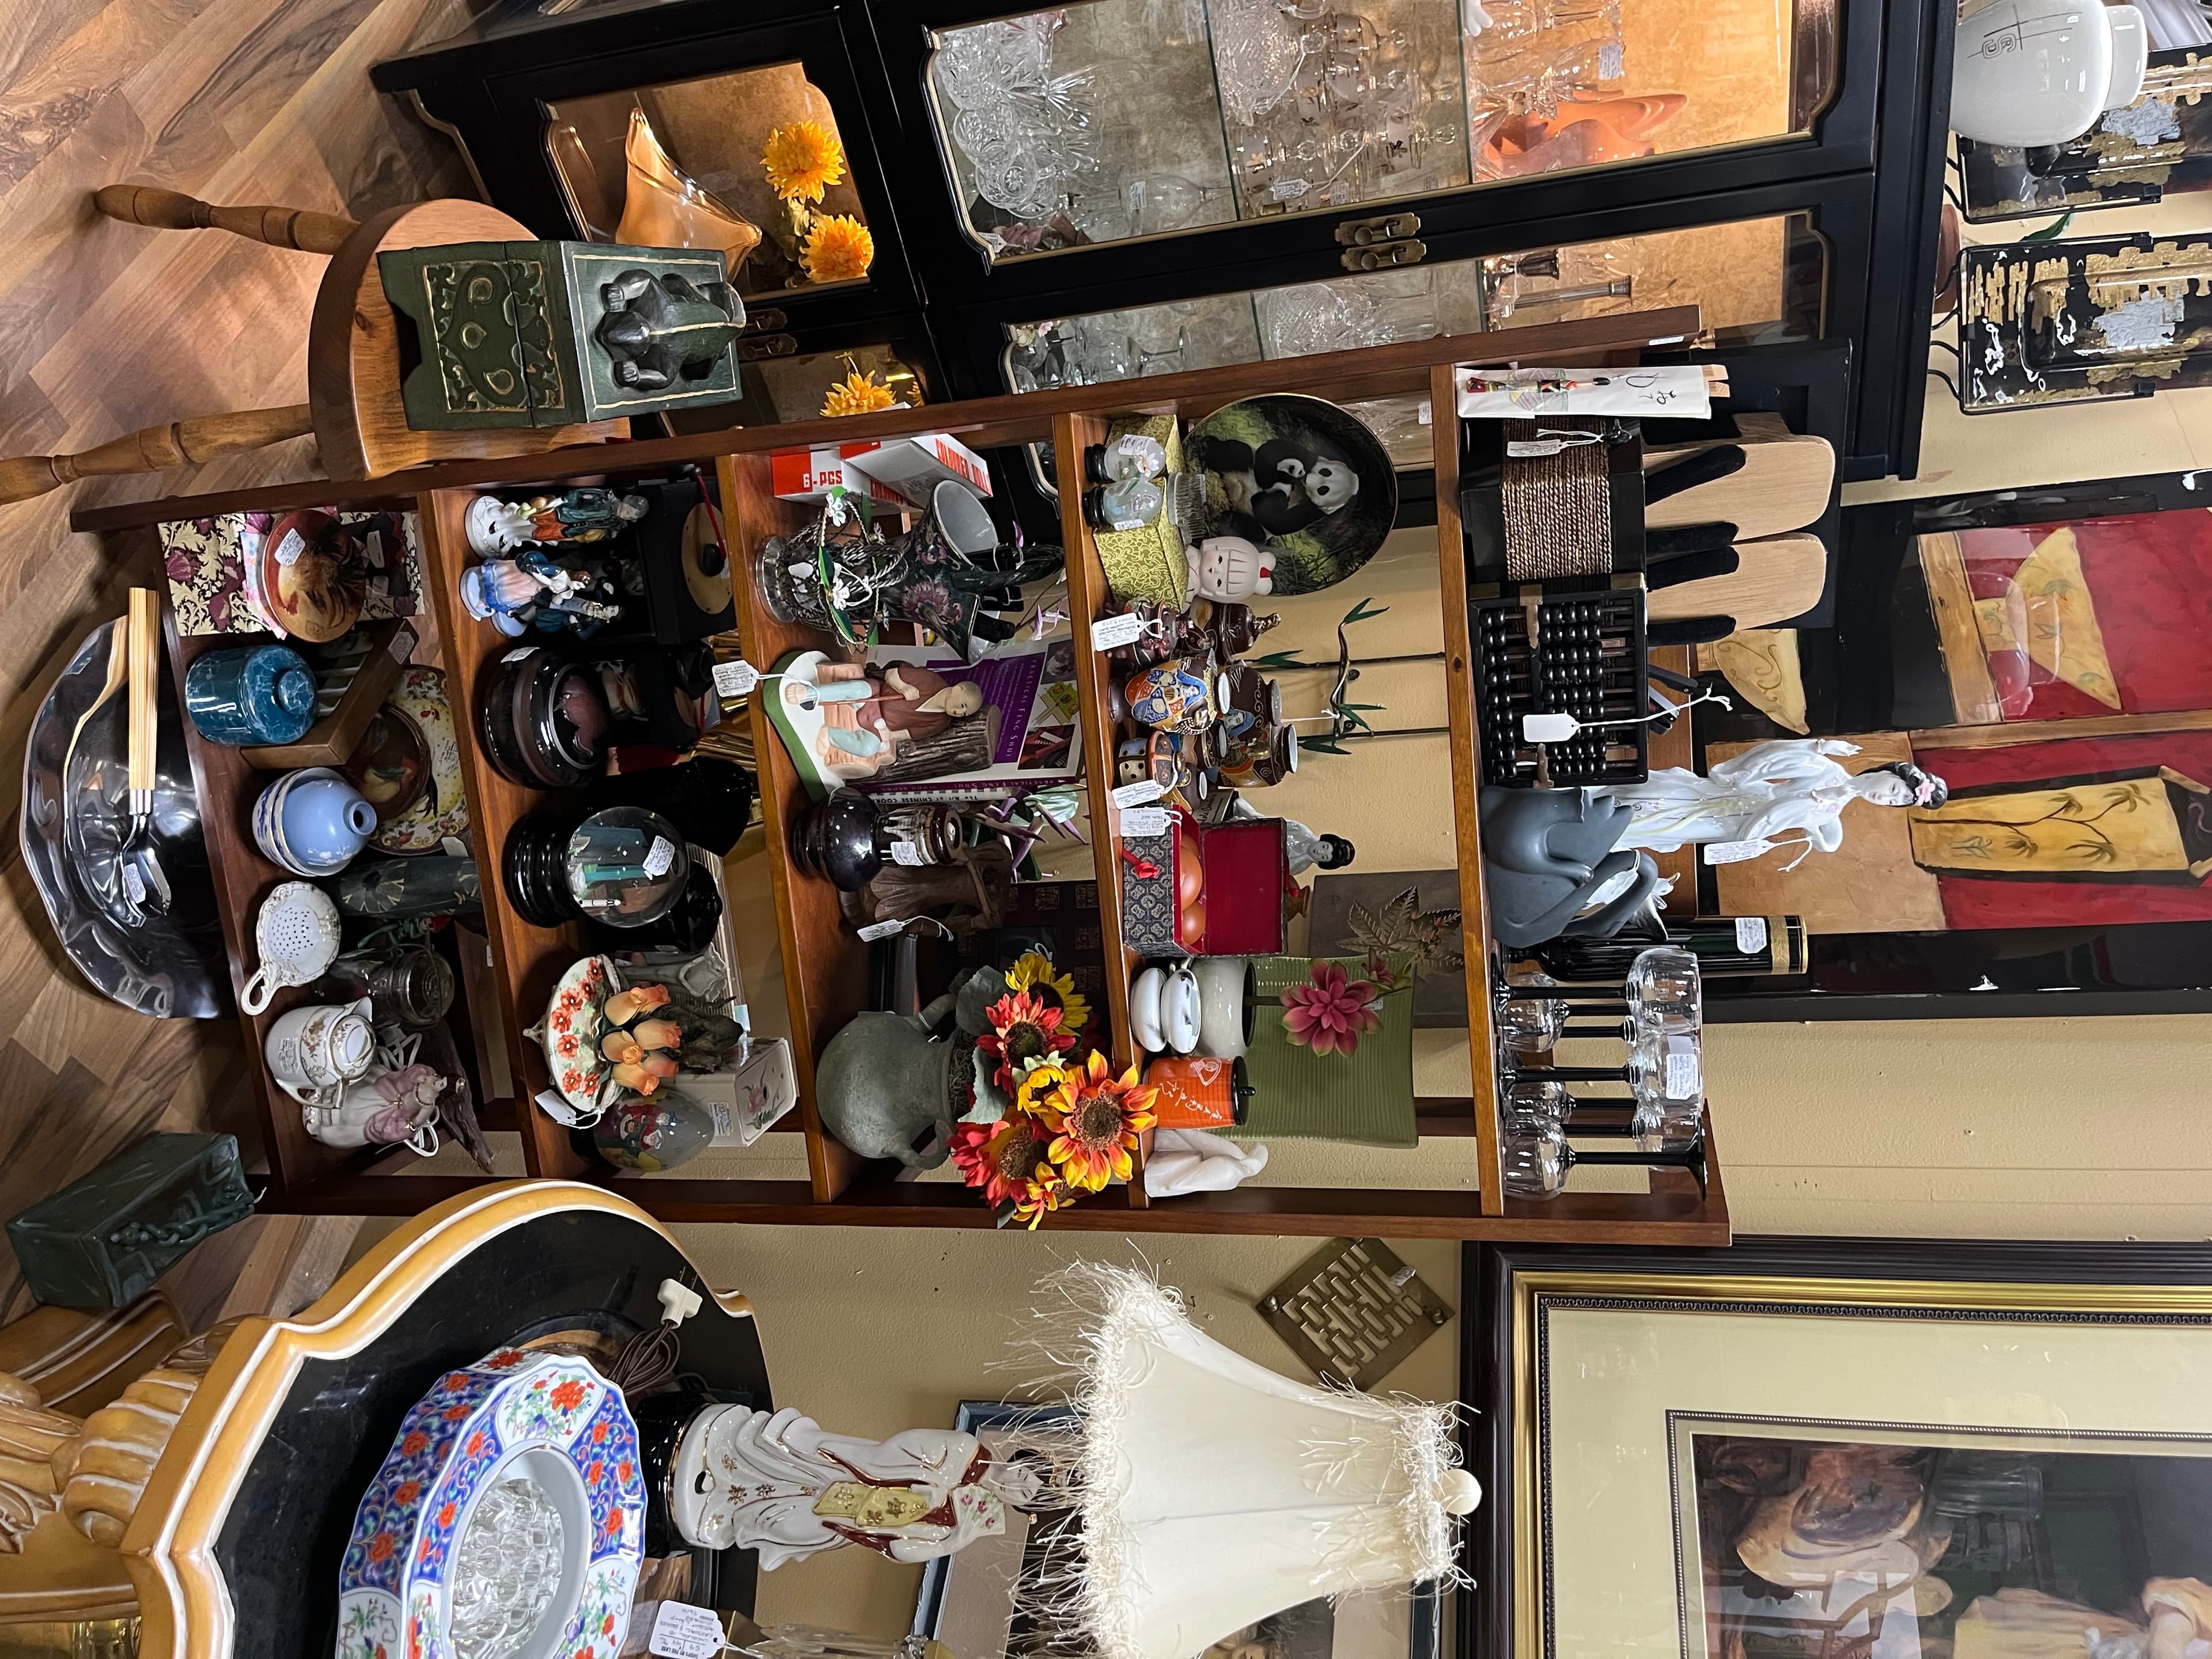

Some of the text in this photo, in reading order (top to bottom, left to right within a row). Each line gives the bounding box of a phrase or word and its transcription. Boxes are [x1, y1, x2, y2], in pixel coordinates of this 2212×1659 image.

[1005, 660, 1037, 757] PRACTICAL FENG SHUI
